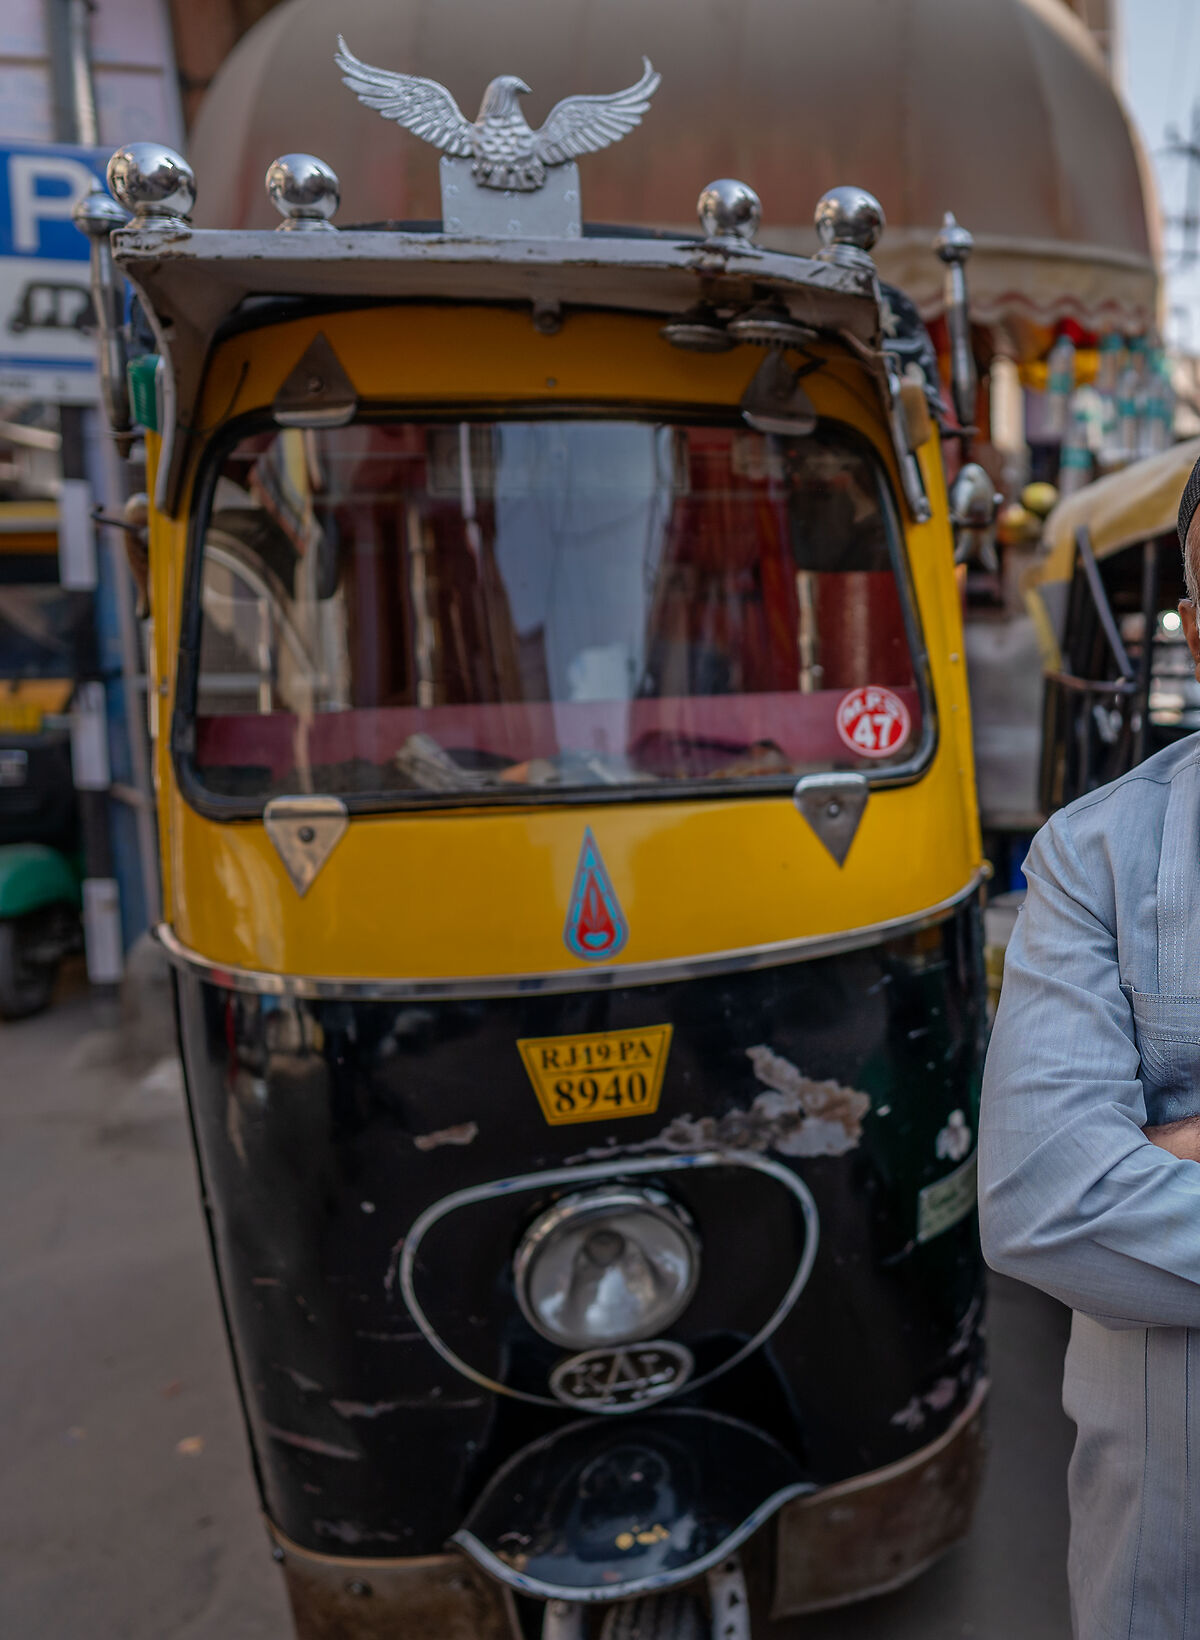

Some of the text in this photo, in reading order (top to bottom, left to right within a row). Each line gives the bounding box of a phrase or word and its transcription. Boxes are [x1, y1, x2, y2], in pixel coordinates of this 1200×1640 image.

[9, 152, 92, 253] P
[853, 714, 894, 748] 47
[554, 1072, 648, 1113] 8940
